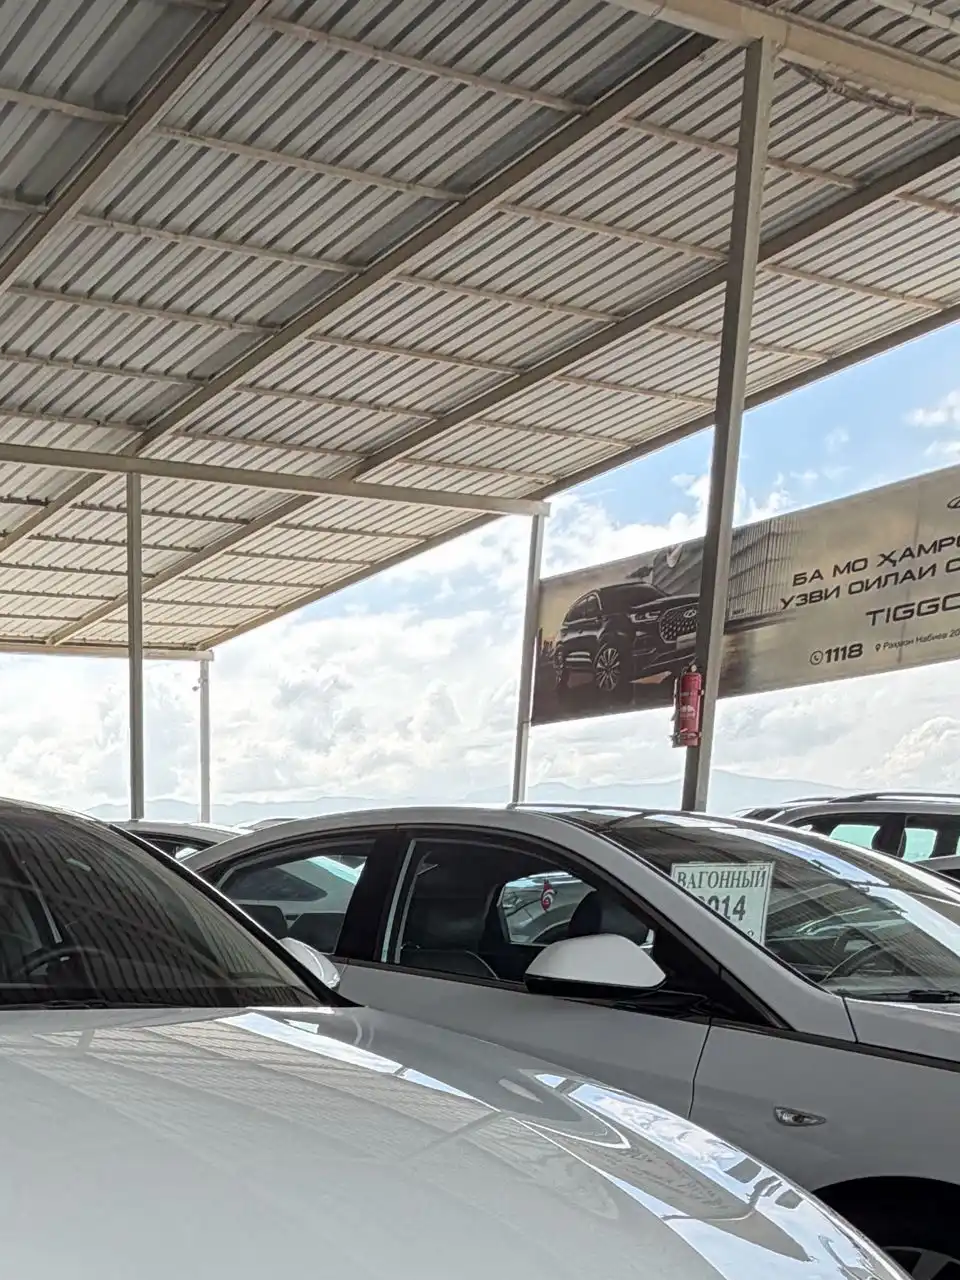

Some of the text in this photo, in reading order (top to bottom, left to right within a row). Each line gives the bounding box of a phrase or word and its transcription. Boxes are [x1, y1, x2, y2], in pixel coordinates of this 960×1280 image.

[792, 535, 960, 587] БА МО ҲАМР
[780, 585, 841, 609] УЗВИ
[847, 563, 937, 596] ОИЛАИ
[824, 642, 864, 663] 1118
[677, 866, 767, 889] ВАГОННЫЙ
[697, 895, 746, 921] 014
